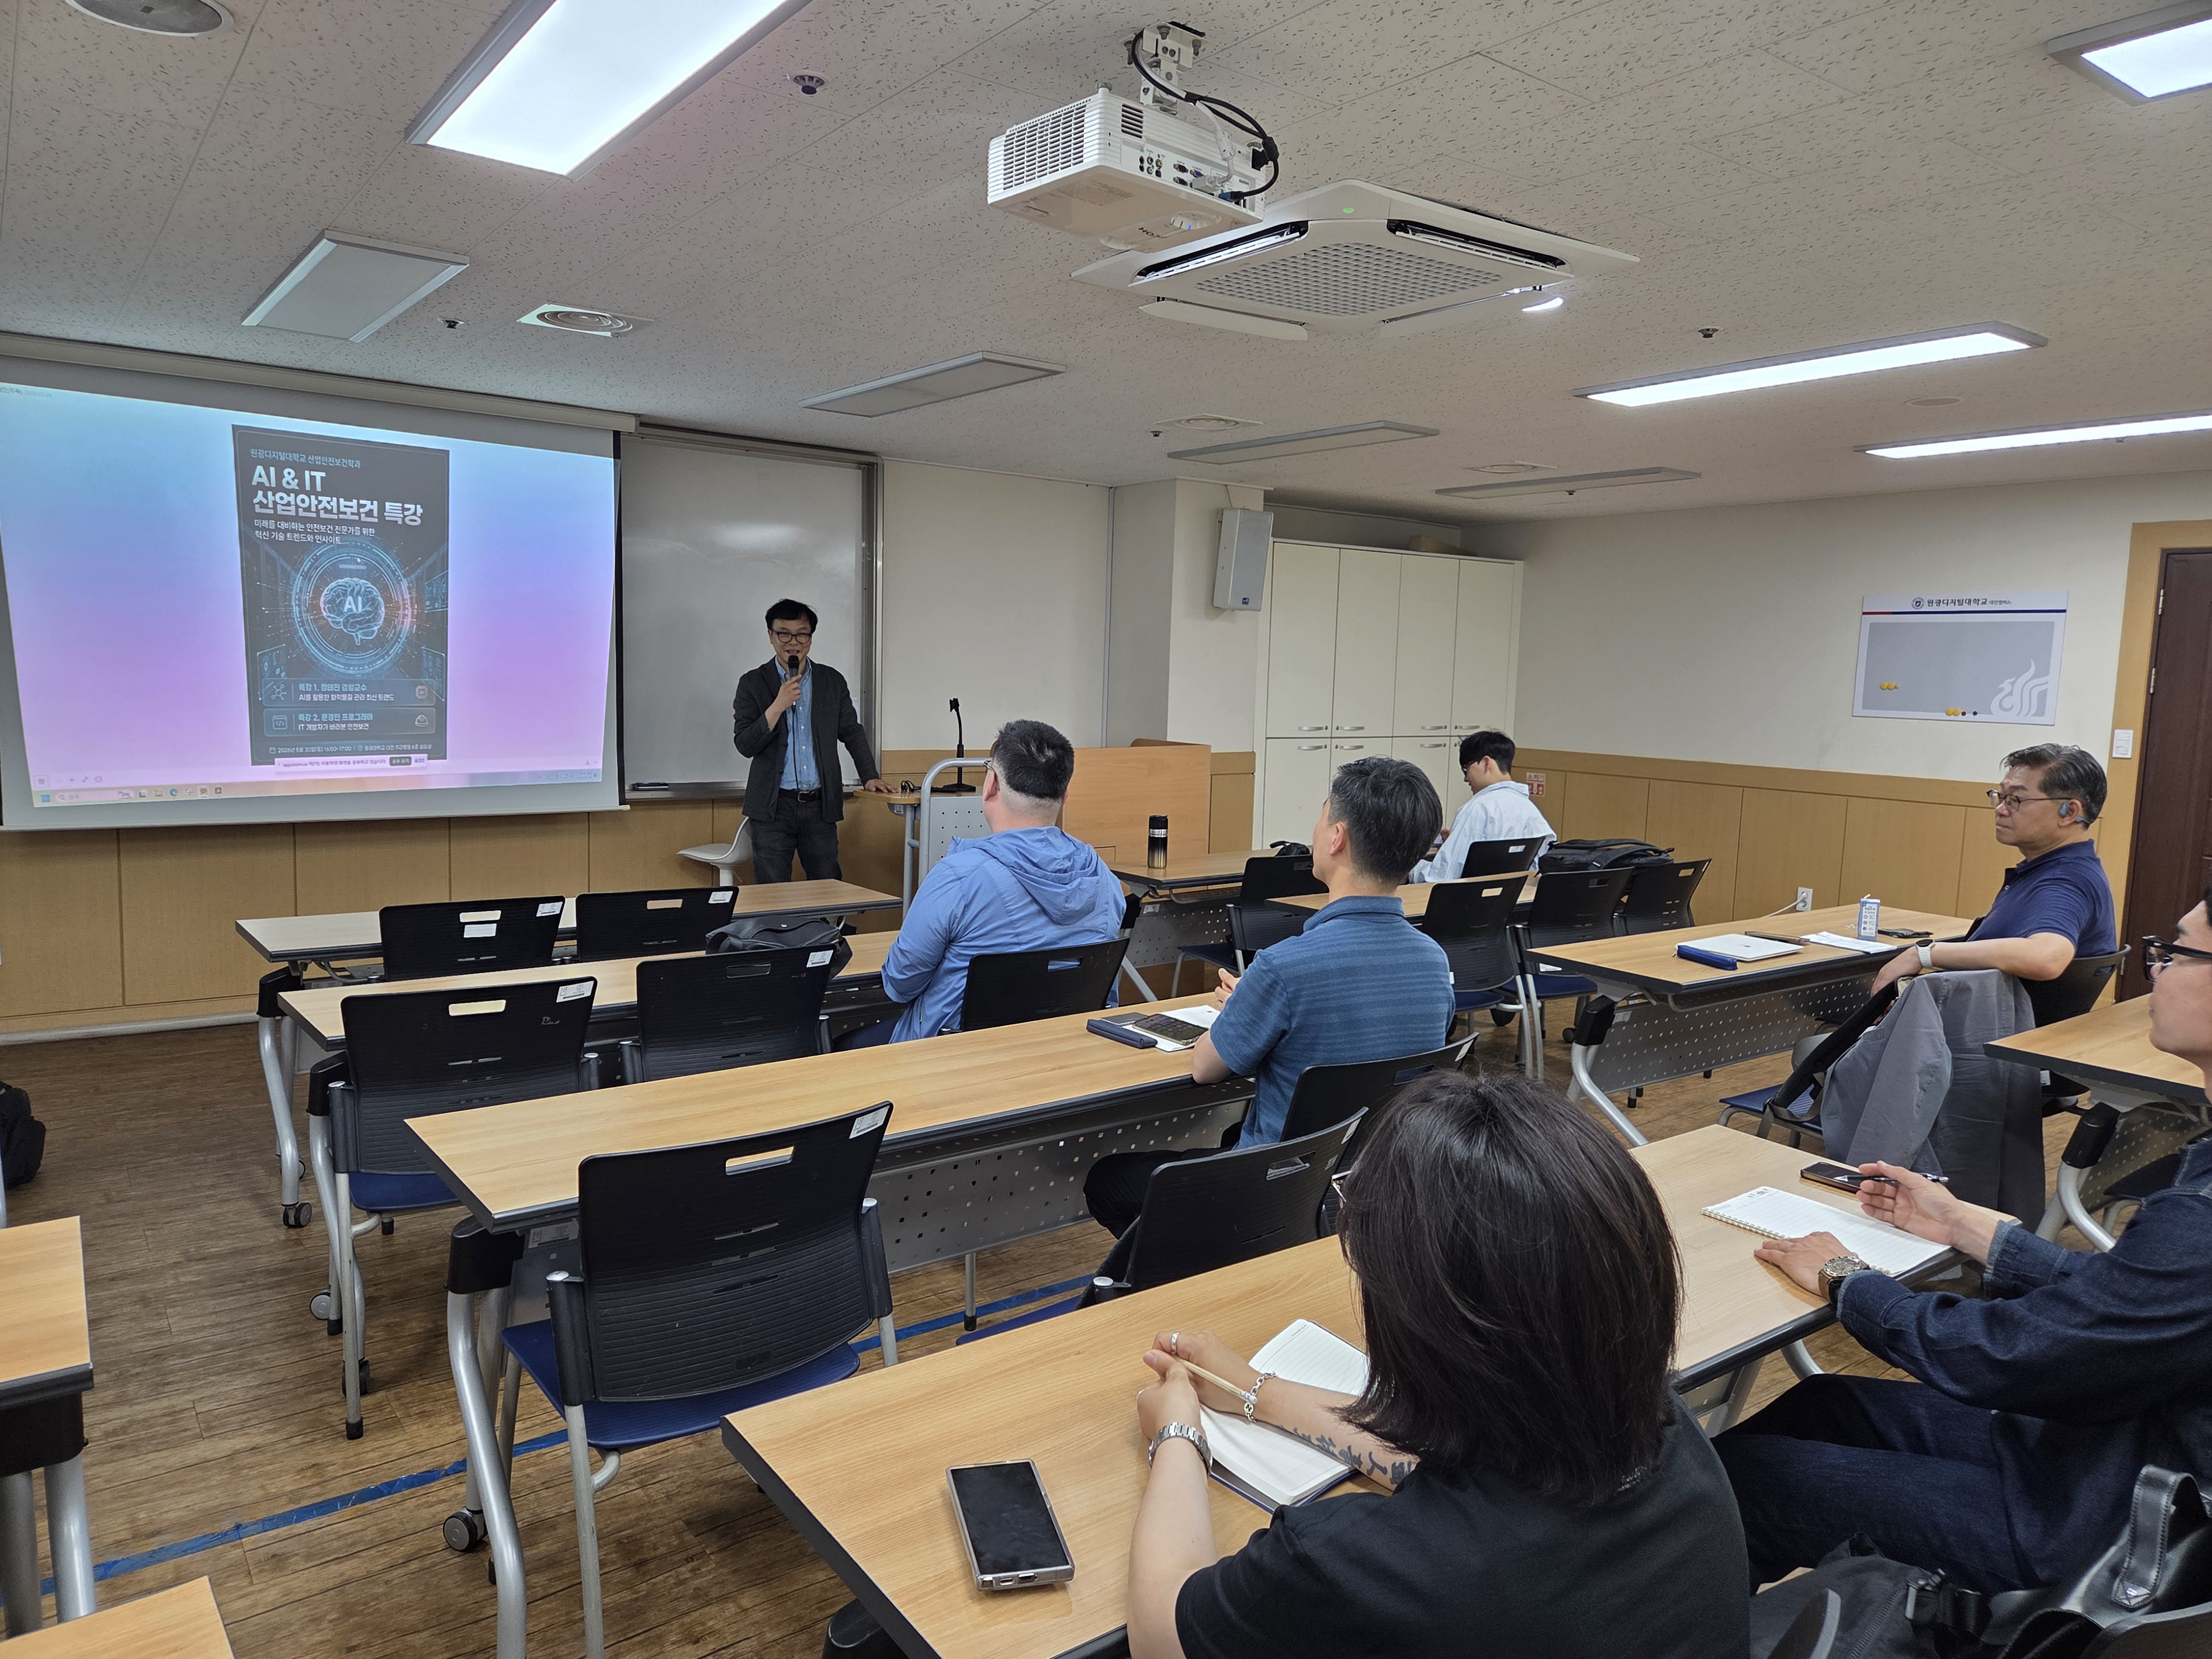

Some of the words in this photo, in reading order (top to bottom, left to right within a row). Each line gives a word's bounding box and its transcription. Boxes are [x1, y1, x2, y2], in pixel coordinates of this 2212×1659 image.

[251, 448, 306, 462] 원광디지털대학교
[308, 455, 361, 468] 산업안전보건학과
[252, 465, 276, 487] AI
[282, 468, 300, 489] &
[305, 470, 326, 492] IT
[253, 490, 378, 523] 산업안전보건
[384, 502, 423, 526] 특강
[254, 519, 275, 529] 미래를
[277, 521, 305, 531] 대비하는
[306, 523, 333, 533] 안전보건
[335, 525, 361, 535] 전문가를
[362, 528, 375, 536] 위한
[255, 530, 269, 540] 혁신
[271, 531, 285, 541] 기술
[286, 533, 314, 542] 트렌드와
[315, 535, 342, 544] 인사이트
[344, 596, 362, 612] AI
[1927, 598, 1987, 607] 원광디지털대학교
